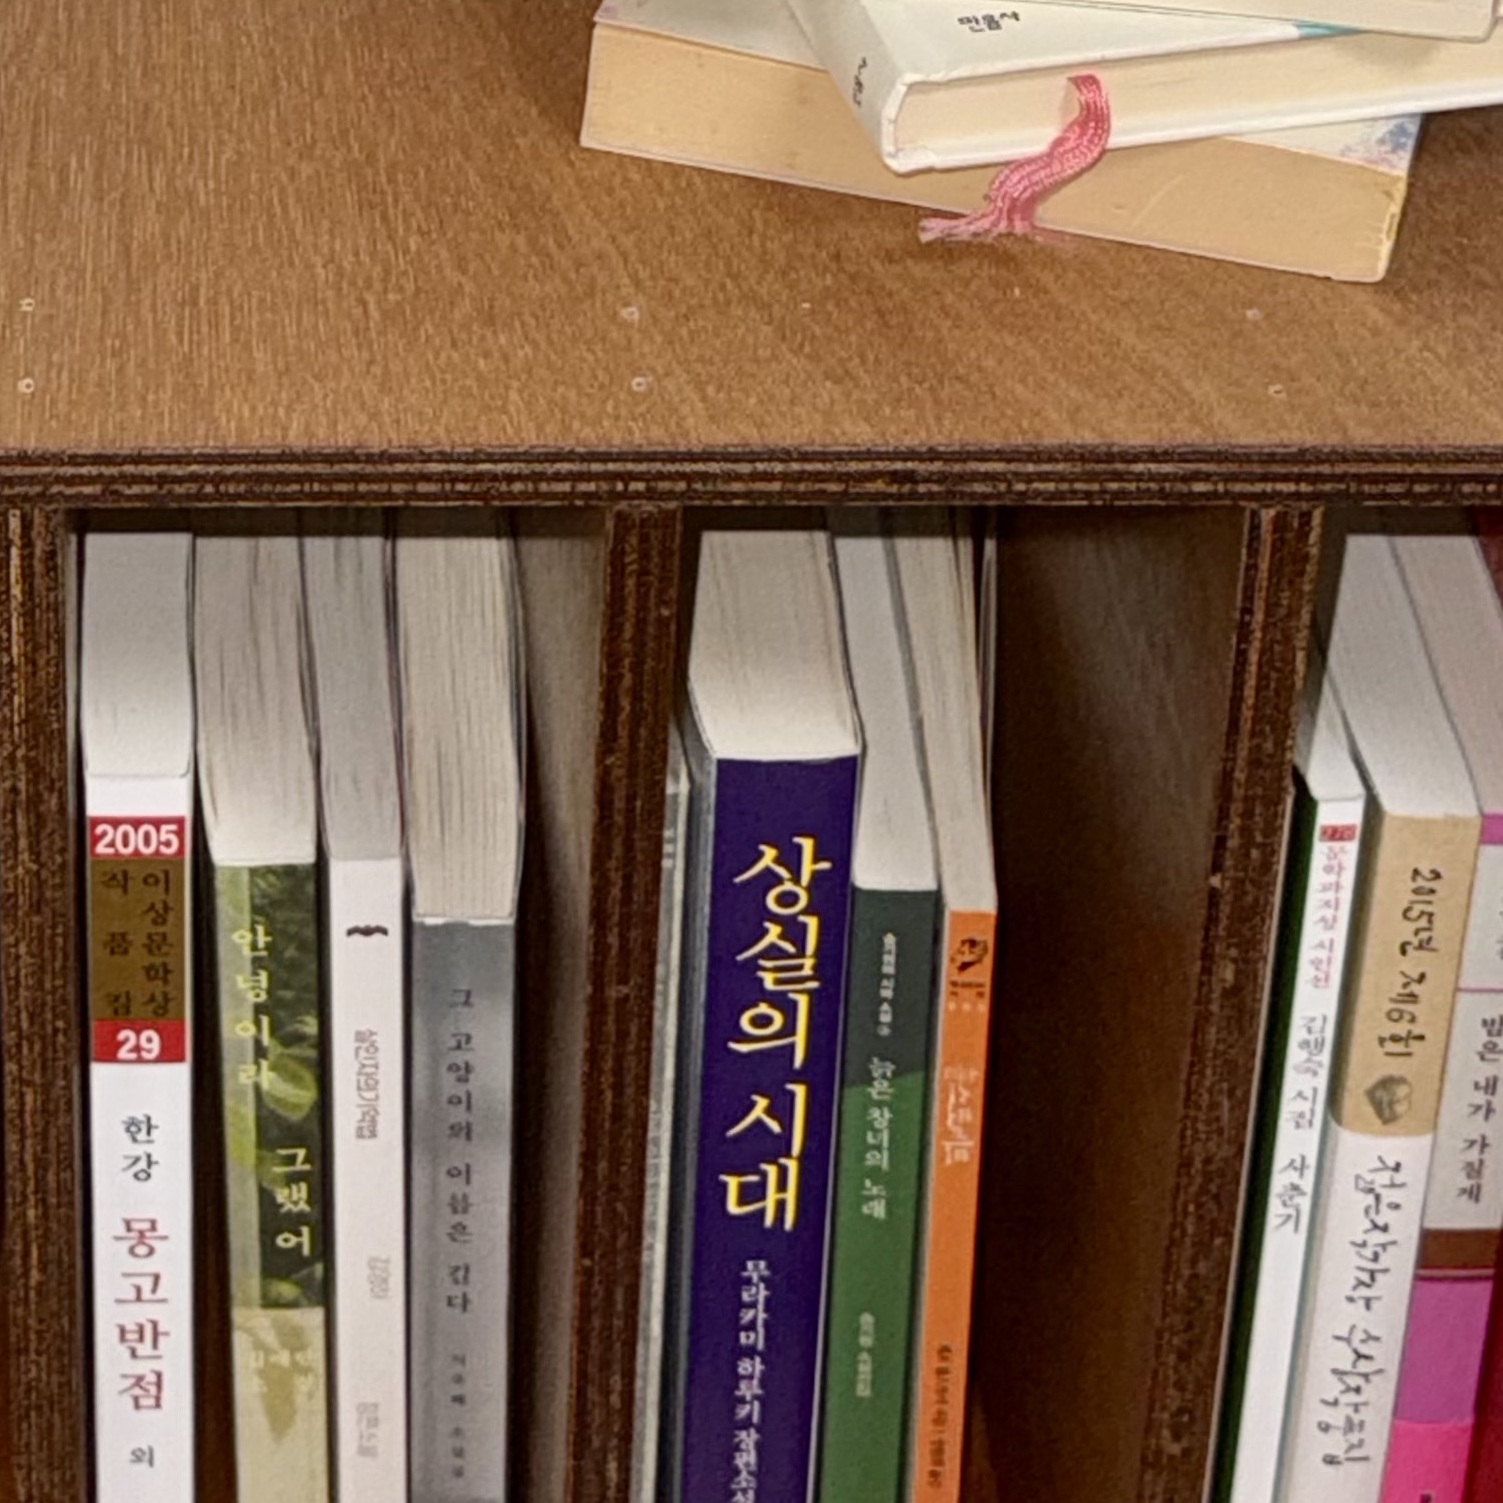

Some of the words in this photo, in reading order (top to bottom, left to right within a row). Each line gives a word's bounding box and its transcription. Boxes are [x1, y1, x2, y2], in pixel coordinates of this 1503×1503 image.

[94, 823, 180, 857] 2005
[140, 869, 174, 1018] 이상문학상
[1399, 866, 1444, 958] 2015년
[726, 836, 833, 1072] 상실의
[448, 987, 475, 1009] 그
[1378, 970, 1427, 1058] 제6회
[116, 1029, 161, 1062] 29
[231, 923, 273, 1090] 안녕이라
[272, 1147, 314, 1258] 그랬어
[446, 1031, 475, 1143] 고양이의
[1467, 1074, 1499, 1125] 내가
[121, 1113, 161, 1184] 한강
[718, 1083, 809, 1232] 시대
[1455, 1135, 1491, 1205] 가질게
[446, 1162, 474, 1245] 이름은
[1272, 1153, 1311, 1235] 사춘기
[112, 1217, 170, 1413] 몽고반점
[446, 1261, 472, 1315] 길다
[739, 1259, 772, 1352] 무라카미
[734, 1354, 766, 1426] 하루키
[129, 1444, 156, 1469] 외
